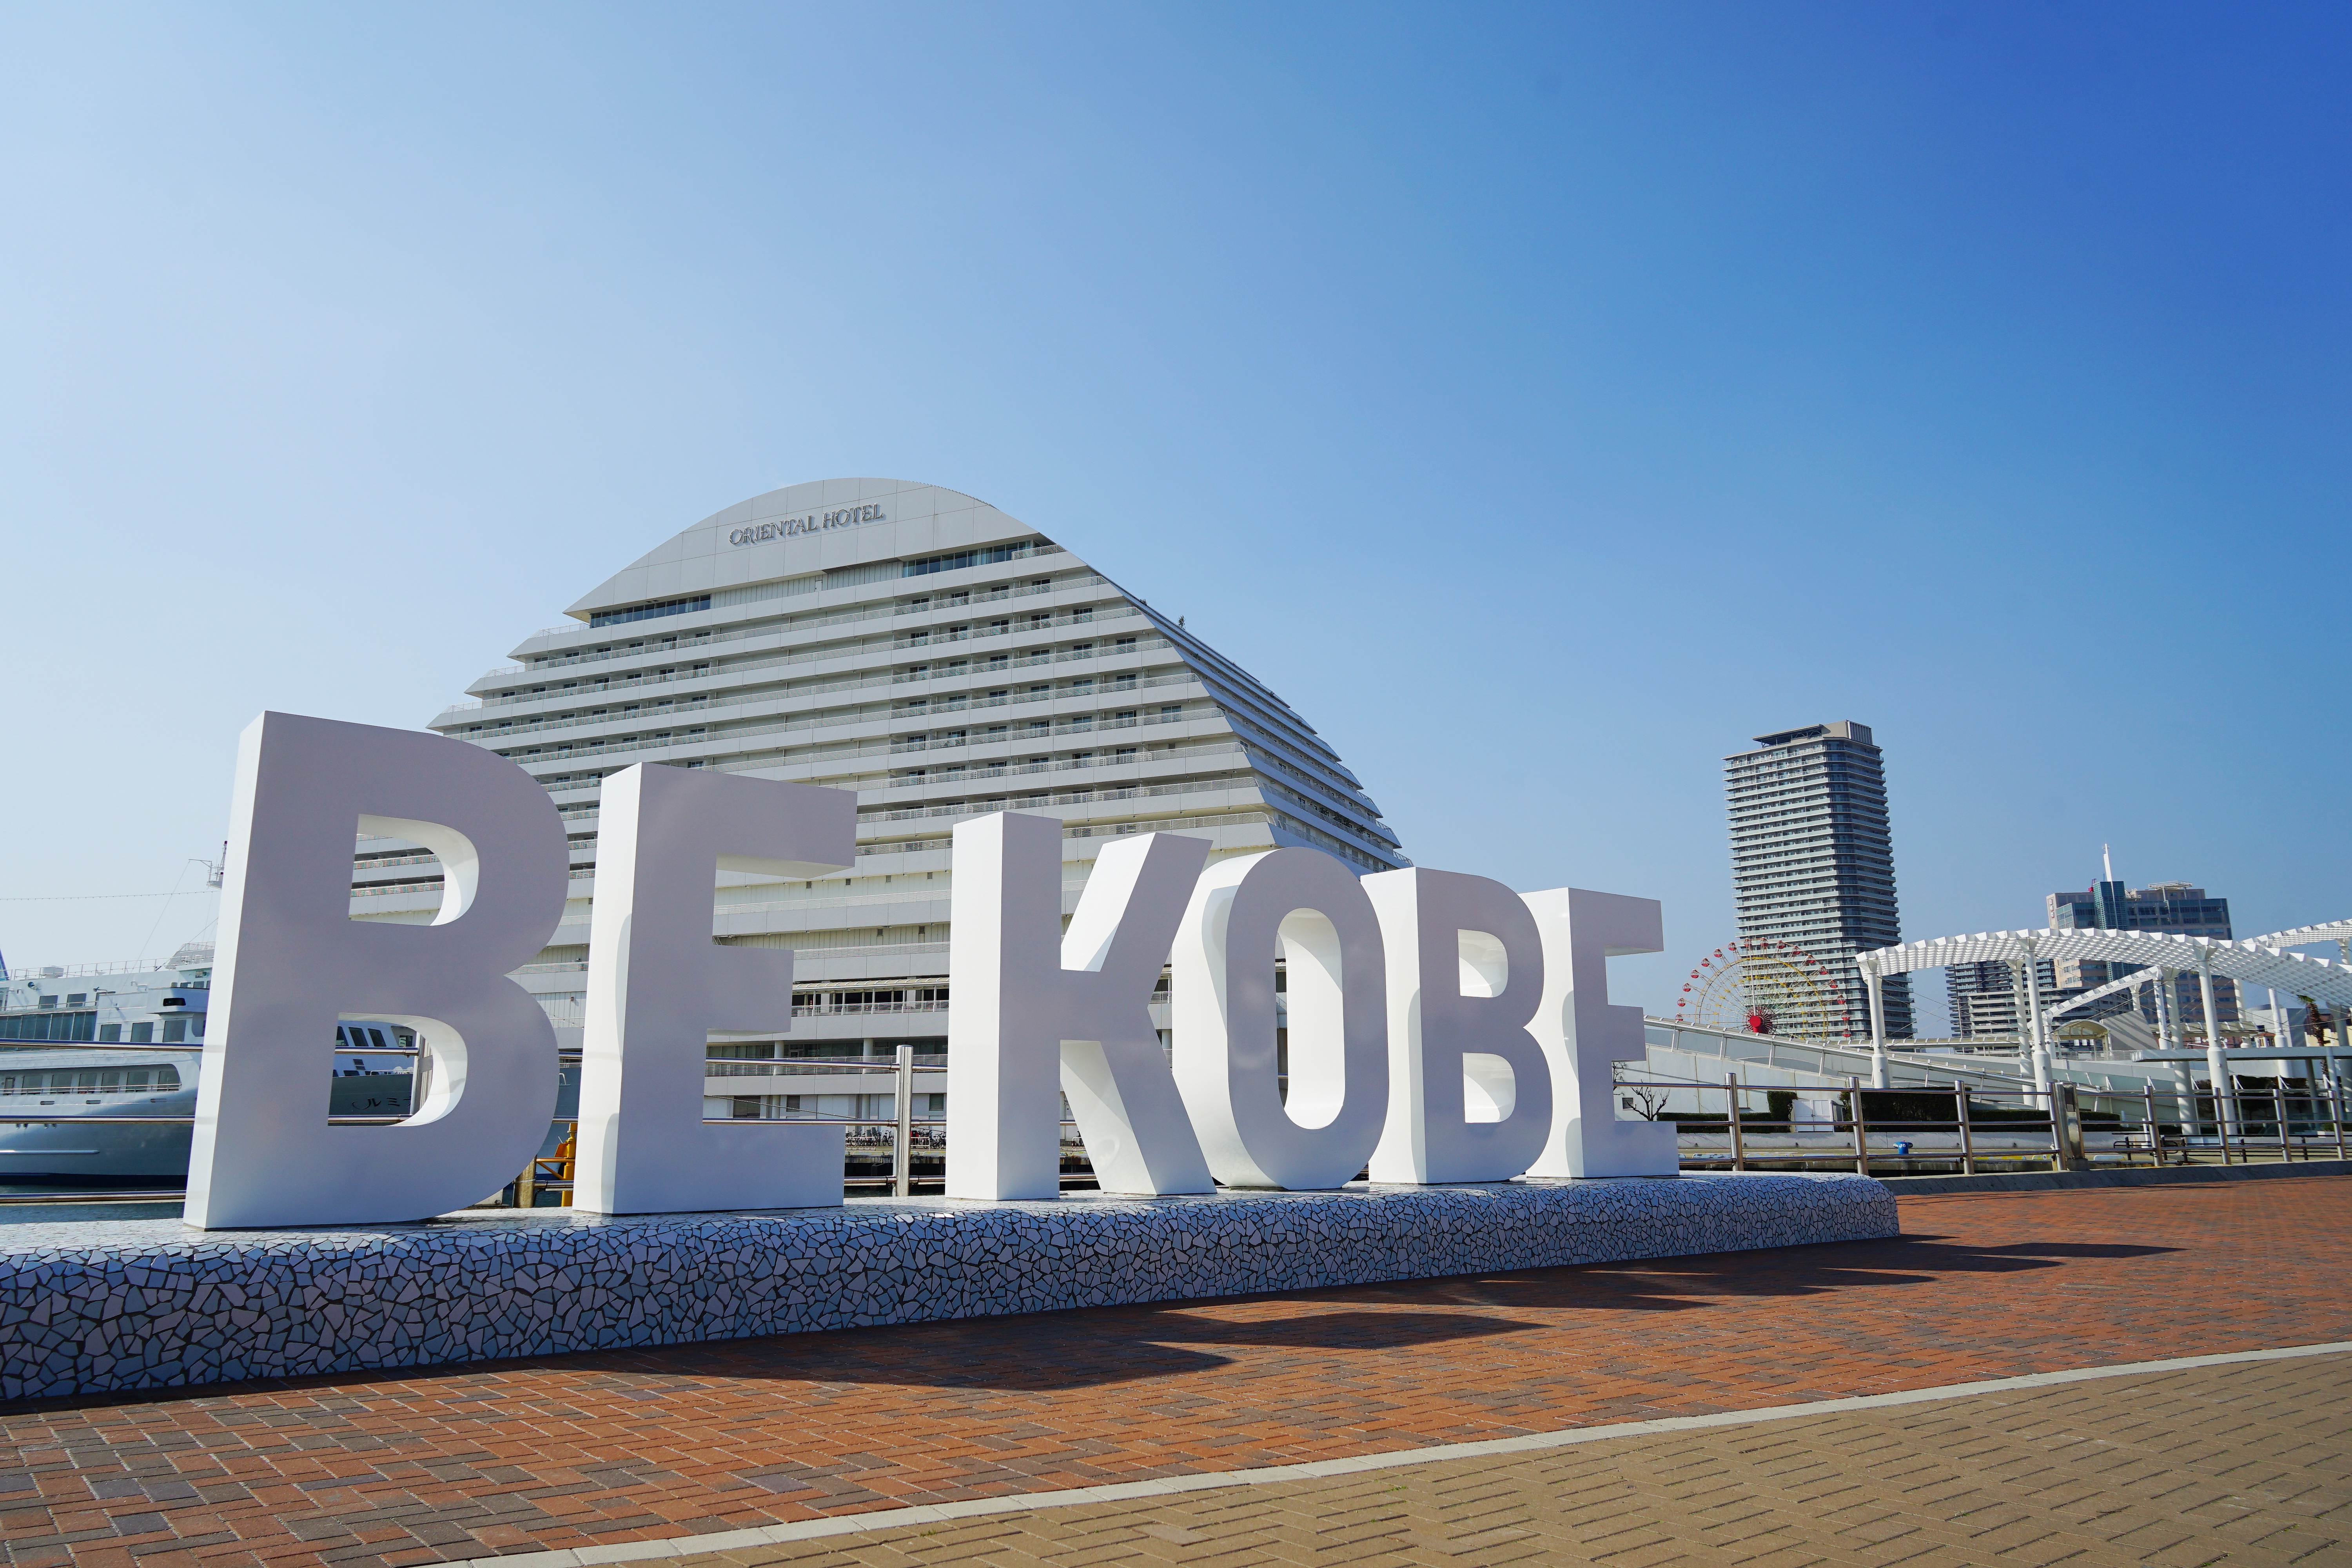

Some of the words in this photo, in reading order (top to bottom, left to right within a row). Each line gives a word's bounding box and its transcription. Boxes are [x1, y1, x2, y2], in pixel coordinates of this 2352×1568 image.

[729, 515, 818, 545] ORIENTAL
[822, 503, 884, 528] HOTEL
[184, 711, 858, 1231] BE
[944, 811, 1680, 1200] KOBE
